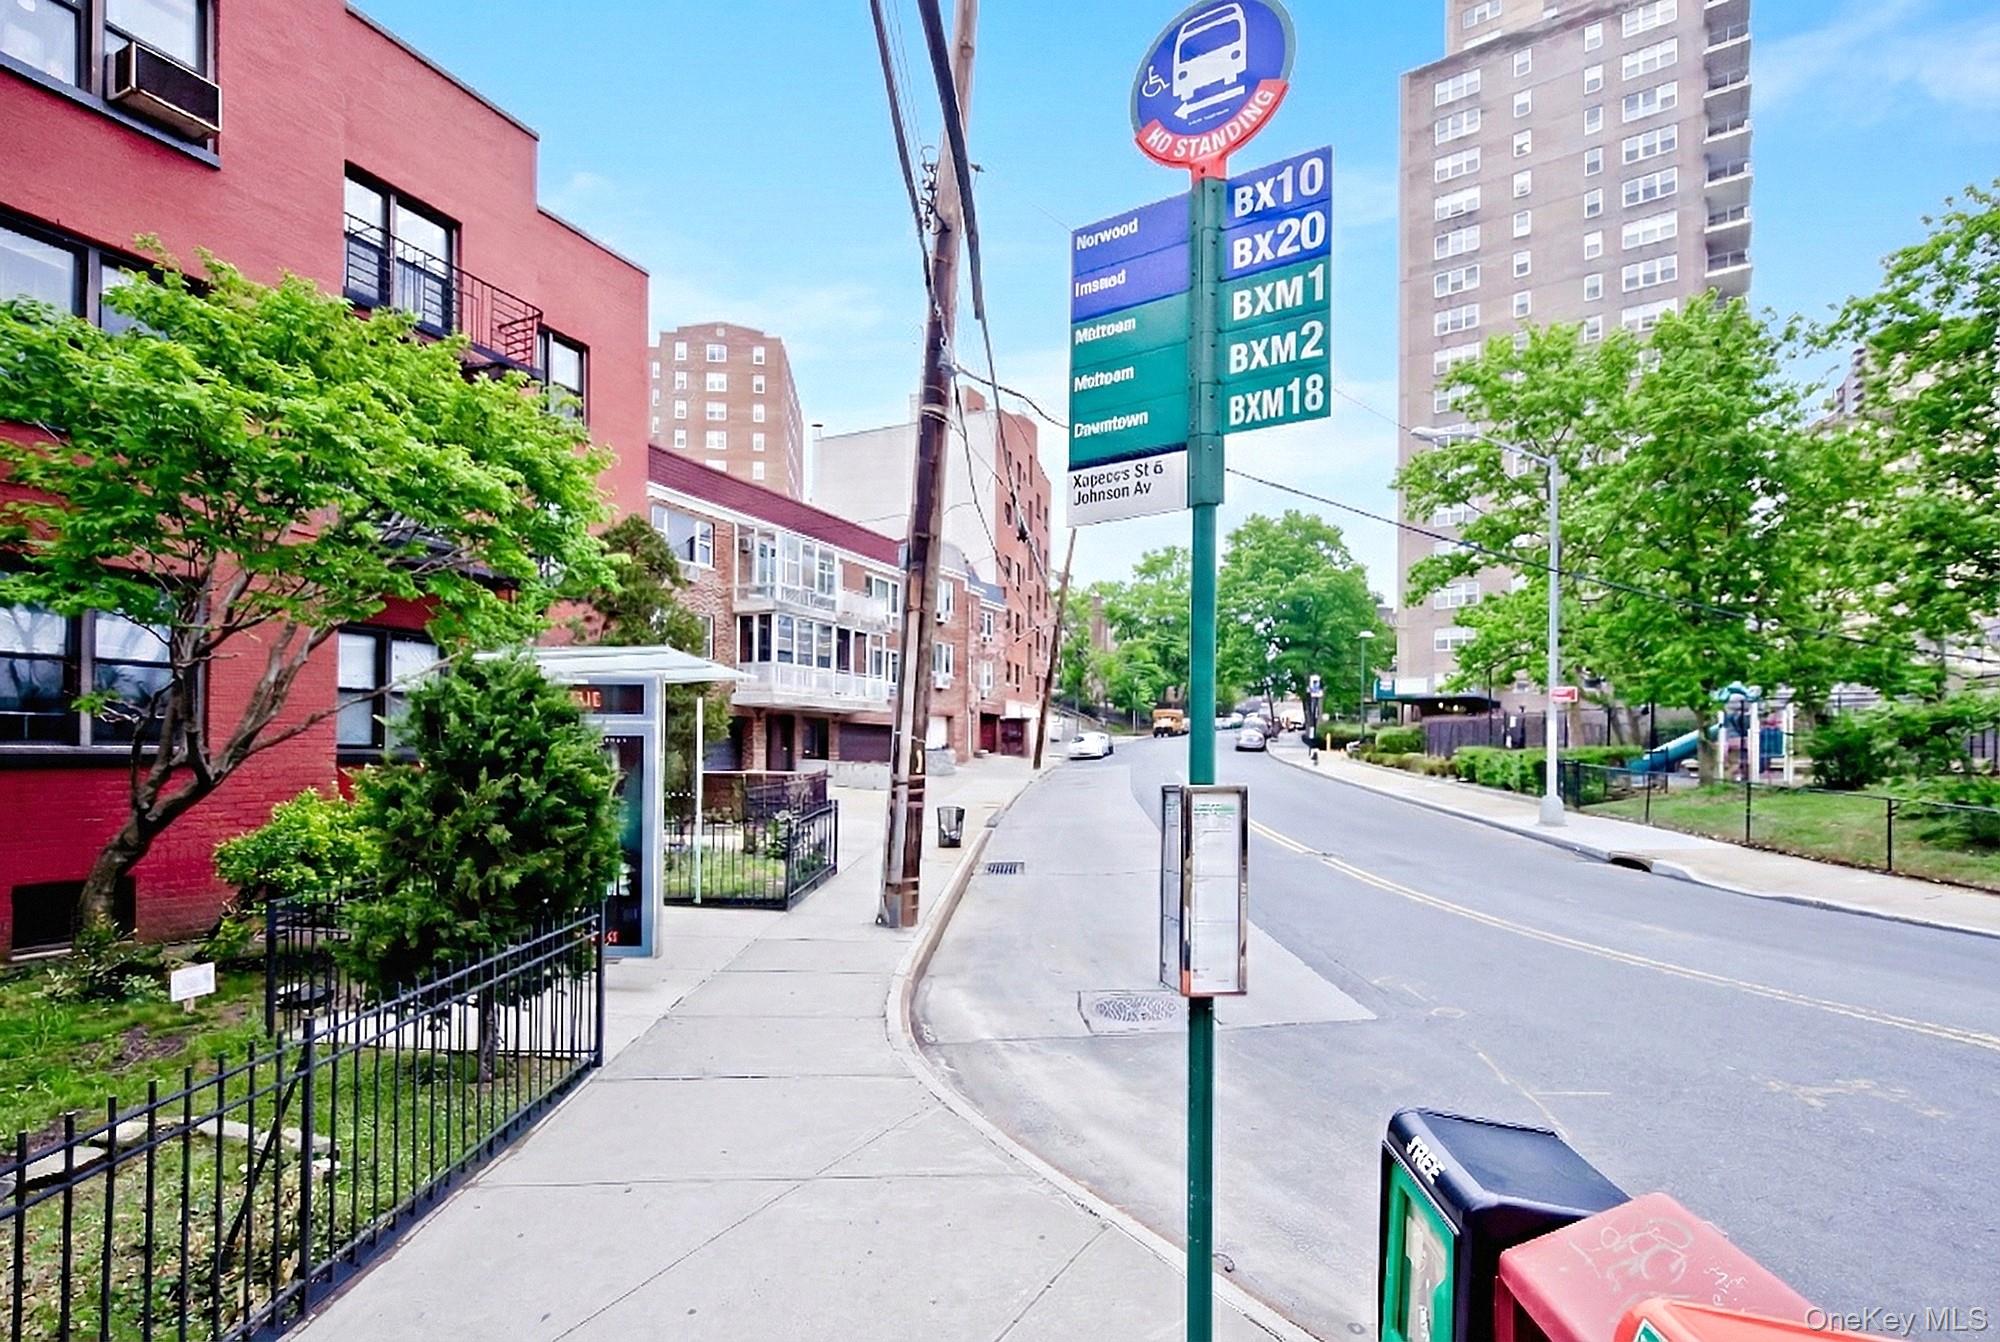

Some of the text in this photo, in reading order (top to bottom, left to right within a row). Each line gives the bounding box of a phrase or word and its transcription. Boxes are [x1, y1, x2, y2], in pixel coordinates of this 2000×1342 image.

[1174, 90, 1275, 158] STANDING
[1234, 157, 1325, 218] BX10
[1076, 218, 1138, 250] Norwood
[1232, 210, 1326, 270] BX20
[1229, 373, 1324, 426] BXM18
[1073, 481, 1152, 506] Johnson Av
[1134, 463, 1149, 478] St
[1406, 1136, 1447, 1185] FREE
